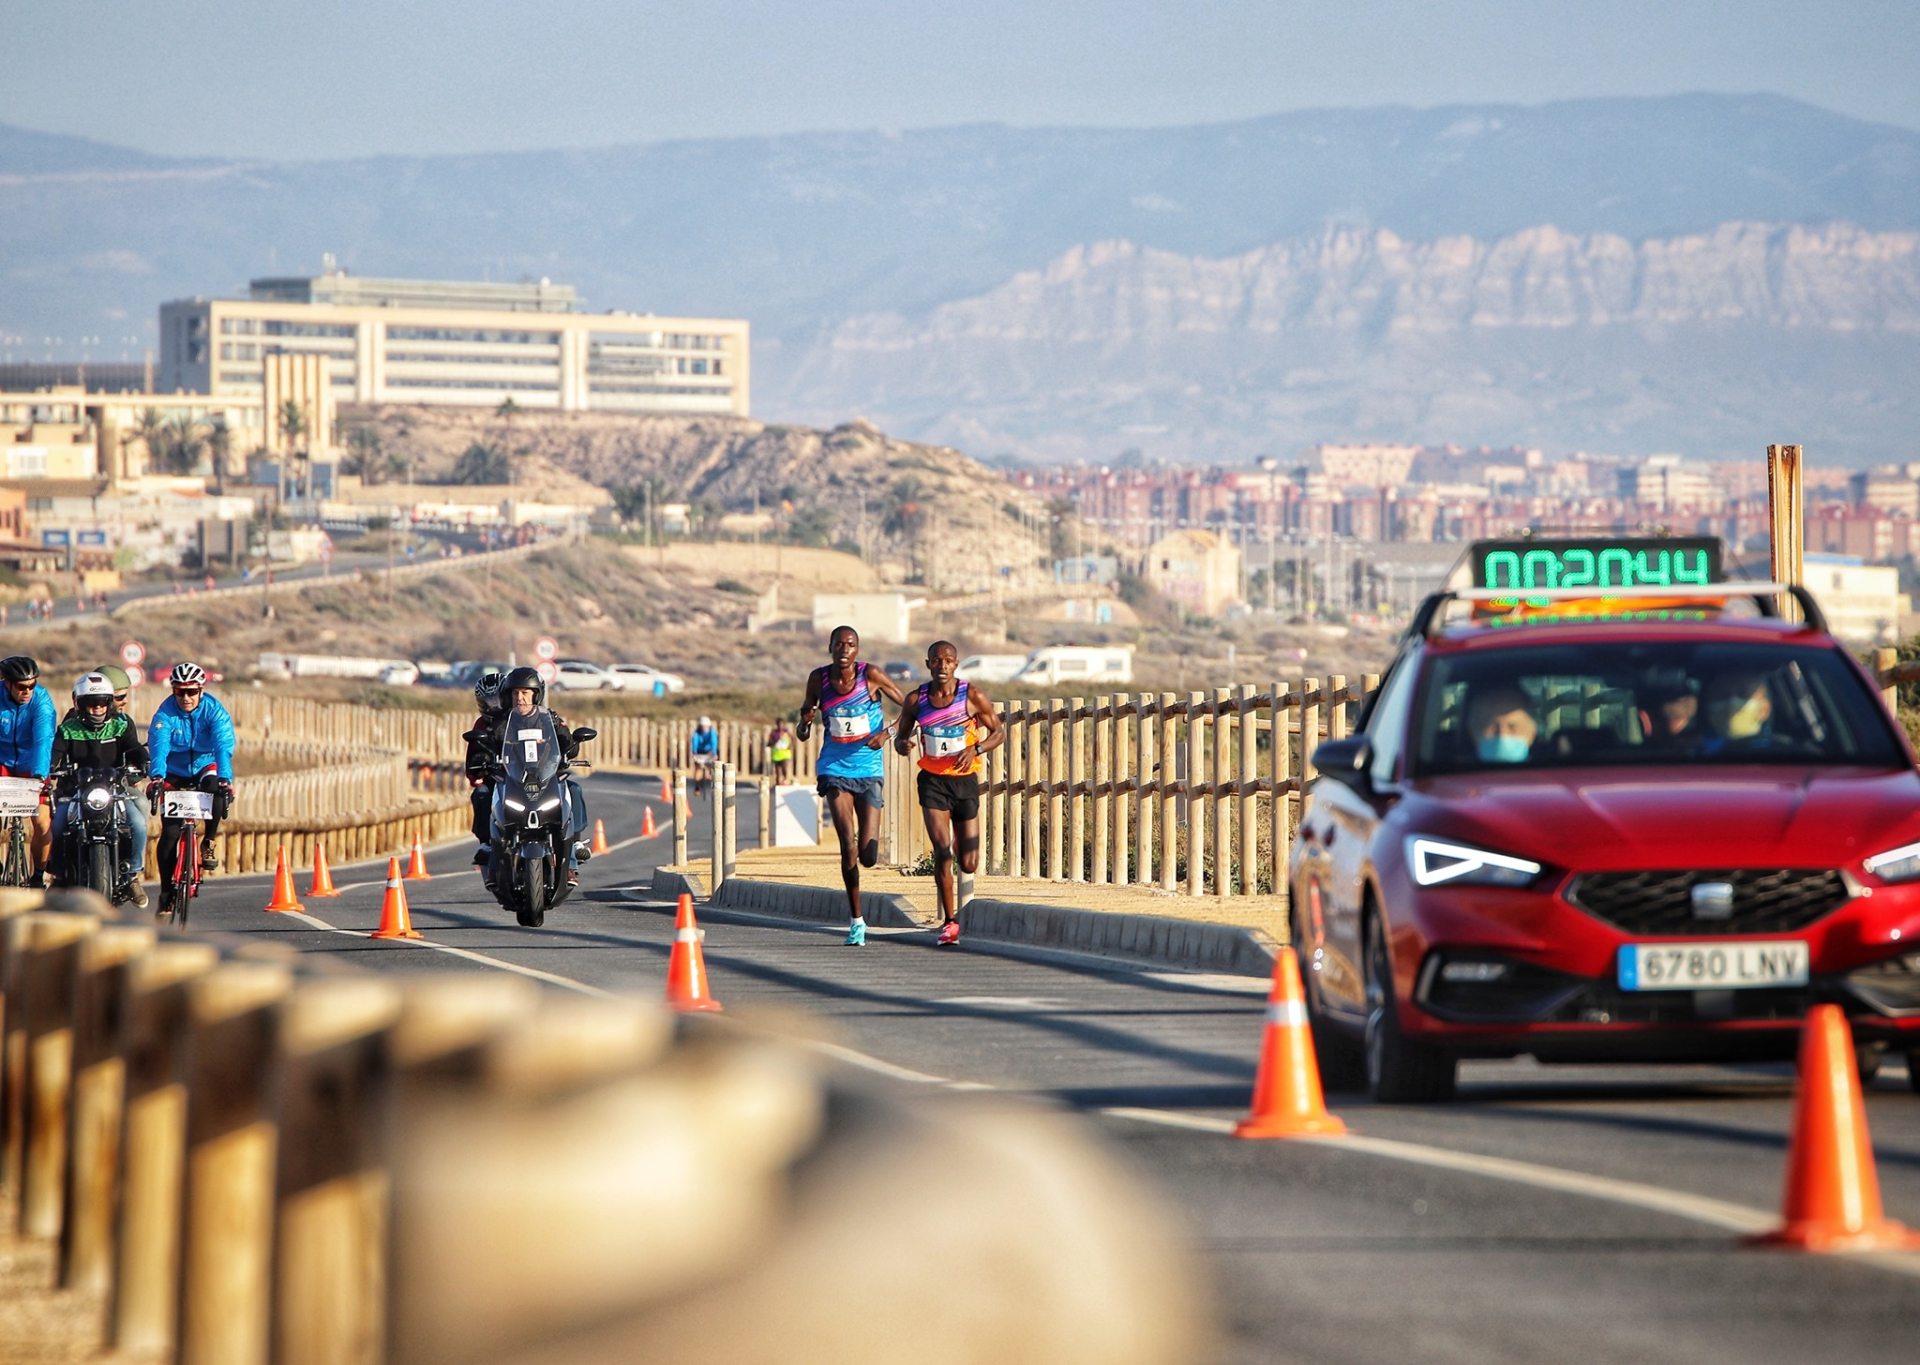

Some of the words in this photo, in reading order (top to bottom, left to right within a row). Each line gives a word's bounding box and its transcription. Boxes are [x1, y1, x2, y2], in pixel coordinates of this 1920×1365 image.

[845, 721, 852, 732] 2
[941, 742, 948, 752] 4
[1644, 950, 1726, 980] 6780
[1739, 947, 1797, 978] LNV
